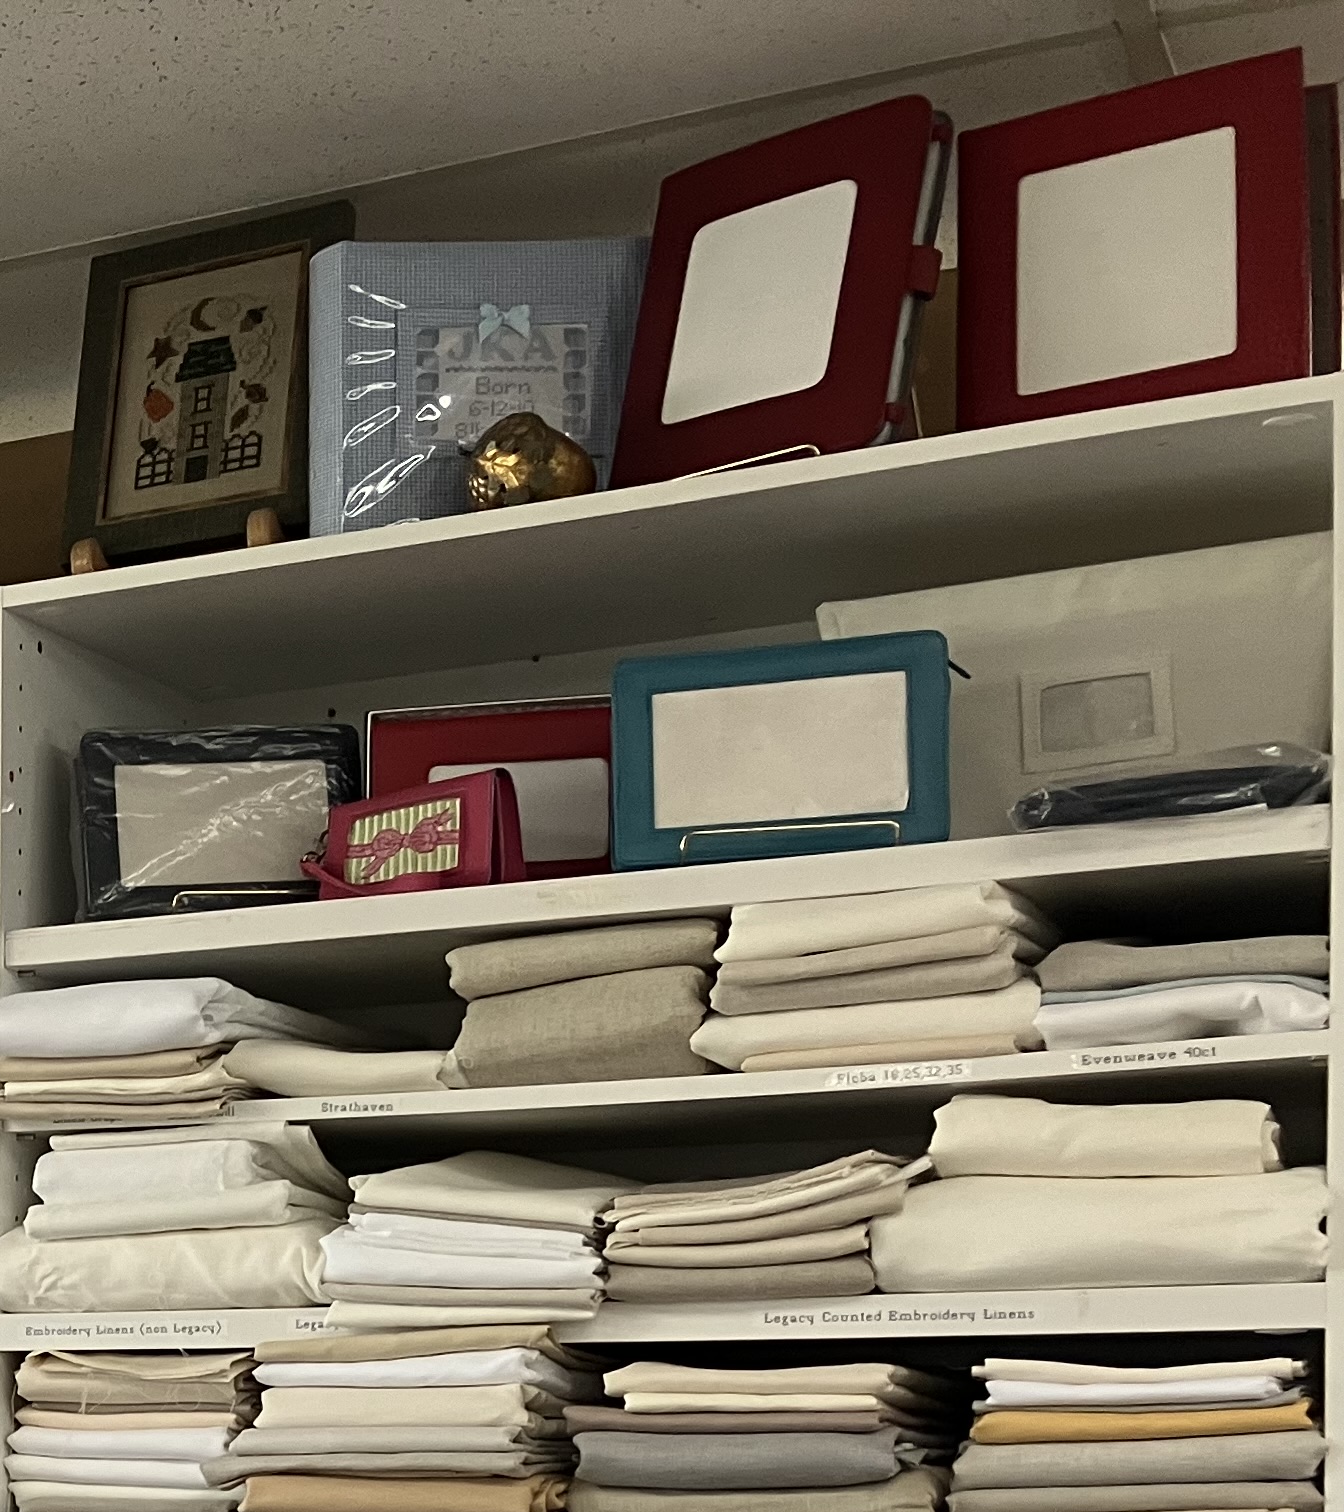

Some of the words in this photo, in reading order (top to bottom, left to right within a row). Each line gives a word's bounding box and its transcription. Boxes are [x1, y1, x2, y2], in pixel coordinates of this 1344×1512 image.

[475, 376, 531, 395] Born
[1080, 1050, 1177, 1067] Evenweave
[1183, 1046, 1217, 1059] 40ct
[321, 1101, 394, 1113] Strathaven
[763, 1312, 814, 1326] Legacy
[821, 1310, 882, 1323] Counted
[887, 1309, 976, 1323] Embroidery
[982, 1308, 1035, 1321] Linens
[25, 1325, 91, 1338] Embroidery
[95, 1323, 134, 1335] Linens
[138, 1323, 168, 1336] (non
[172, 1320, 222, 1336] Legacy)
